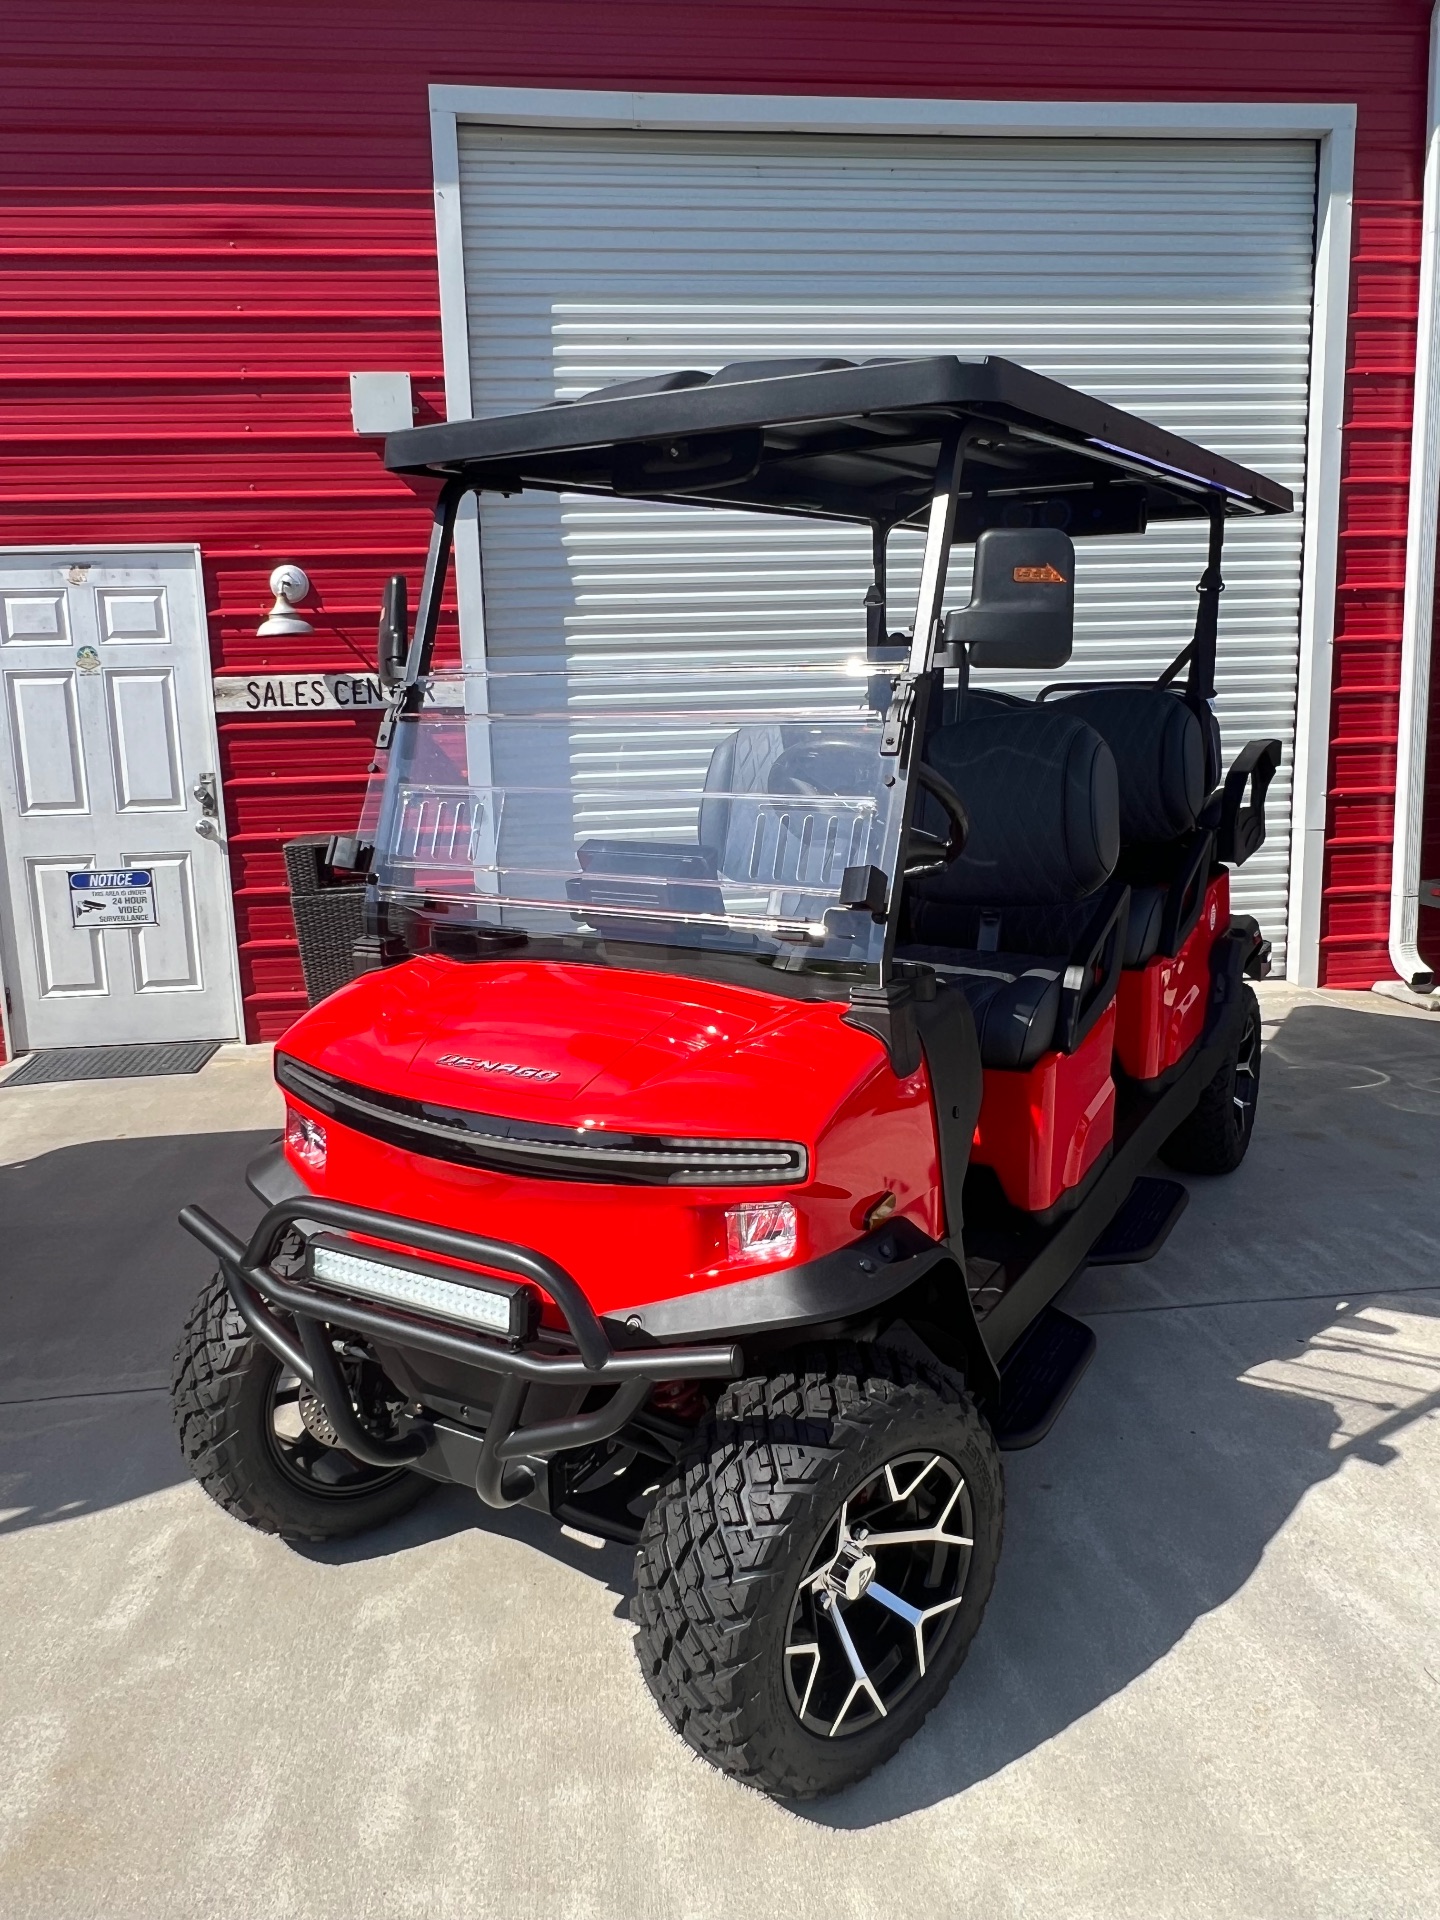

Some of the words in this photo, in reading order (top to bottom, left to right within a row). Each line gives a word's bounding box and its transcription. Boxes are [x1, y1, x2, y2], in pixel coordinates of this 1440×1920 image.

[246, 680, 325, 710] SALES
[89, 873, 133, 887] NOTICE
[112, 897, 122, 905] 24
[124, 896, 147, 904] HOUR
[118, 905, 143, 914] VIDEO
[99, 914, 149, 923] SURVEILLANCE
[436, 1053, 561, 1082] DENAGO
